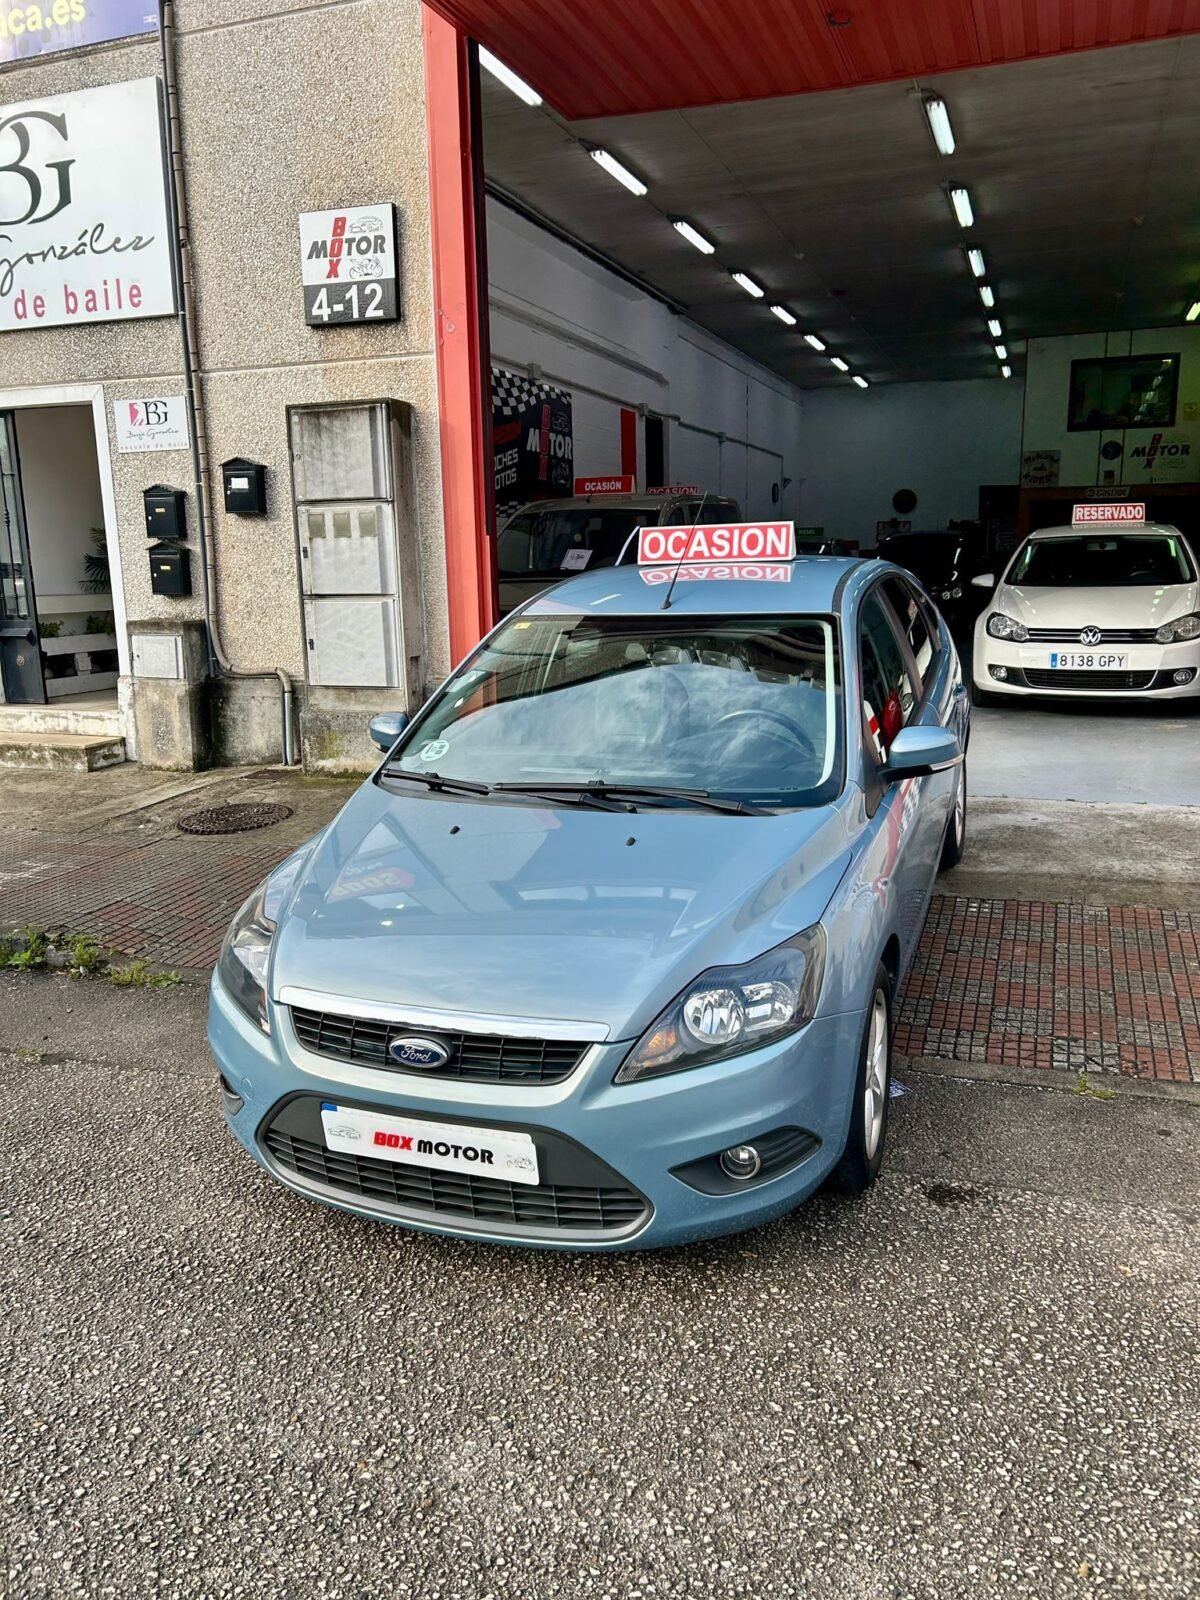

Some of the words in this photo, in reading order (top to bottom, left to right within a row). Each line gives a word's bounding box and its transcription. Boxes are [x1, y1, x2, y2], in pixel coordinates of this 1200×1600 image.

[307, 234, 387, 260] MOTOR
[14, 289, 45, 320] de
[64, 278, 142, 315] baile
[311, 282, 384, 322] 4-12
[1075, 506, 1143, 520] RESERVADO
[643, 527, 787, 559] OCASION
[1060, 655, 1094, 667] 8138
[1098, 655, 1125, 668] GPY
[400, 1044, 432, 1062] Ford
[373, 1131, 414, 1151] BOX
[416, 1139, 494, 1165] MOTOR
